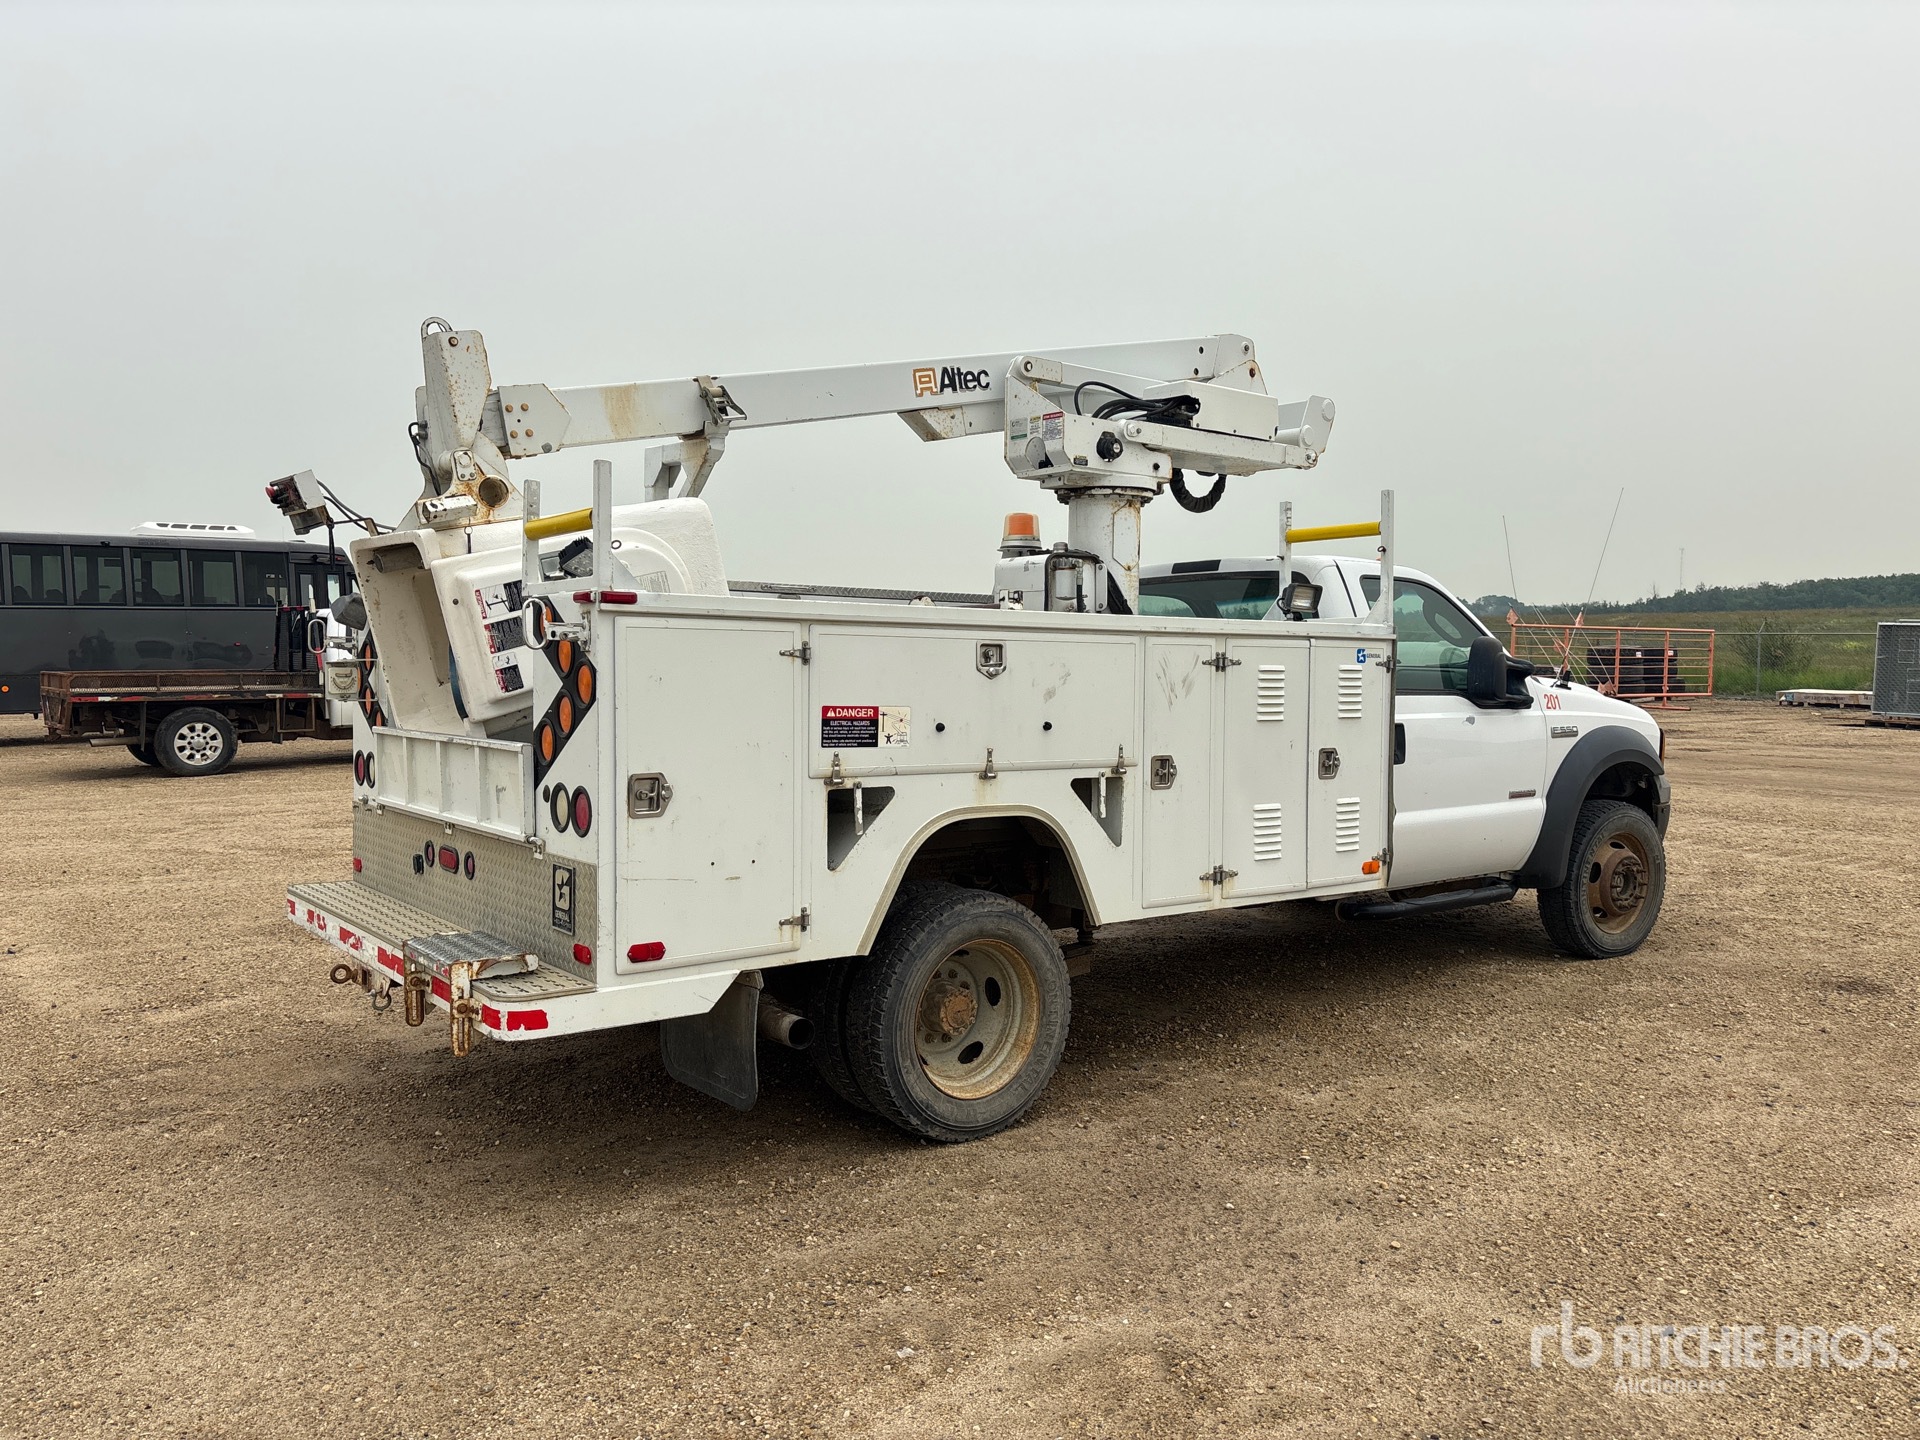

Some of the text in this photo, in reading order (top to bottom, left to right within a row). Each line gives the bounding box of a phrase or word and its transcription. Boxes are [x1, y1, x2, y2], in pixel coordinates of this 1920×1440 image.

[939, 366, 990, 394] Altec
[836, 708, 874, 717] DANGER
[1544, 693, 1561, 710] 201
[1012, 966, 1061, 1096] CONTINENTAL
